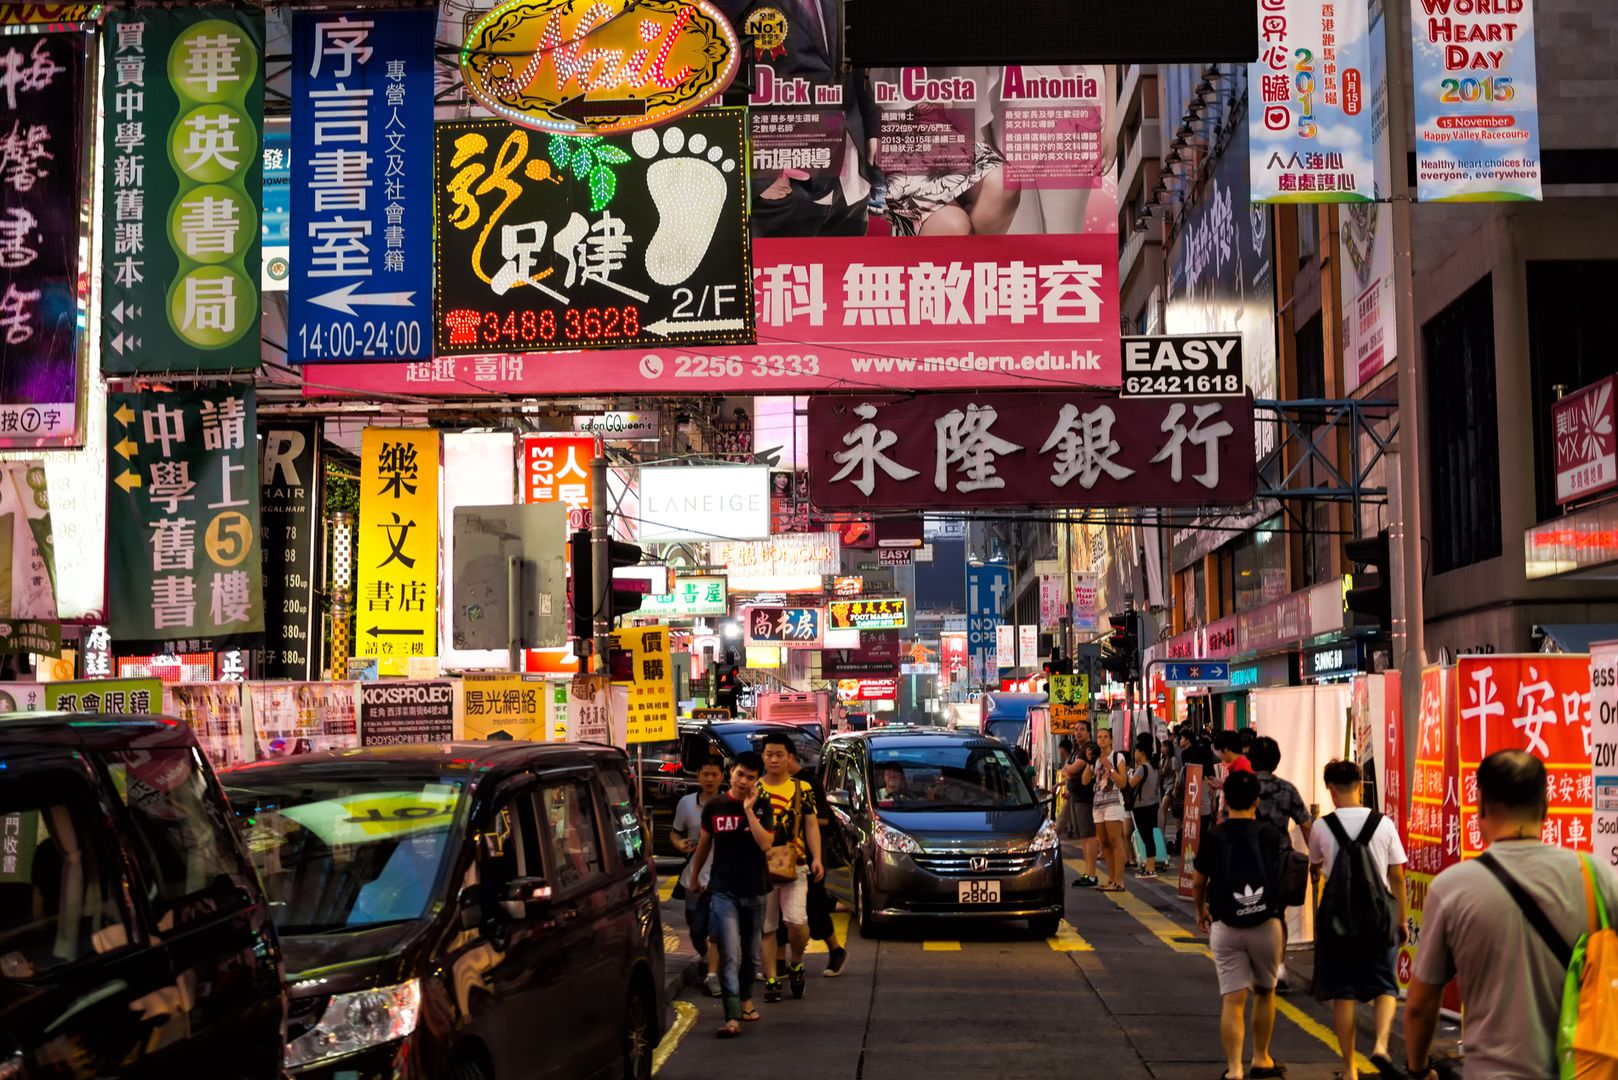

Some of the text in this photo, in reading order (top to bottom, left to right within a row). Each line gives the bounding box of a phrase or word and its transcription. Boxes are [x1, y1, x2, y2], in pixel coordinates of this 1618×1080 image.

[750, 22, 784, 34] No.1
[1428, 17, 1518, 42] HEART
[481, 0, 695, 96] Nail
[1445, 45, 1504, 70] DAY
[749, 65, 843, 105] Dick Hui
[876, 67, 976, 102] Dr. Costa
[1001, 65, 1099, 99] Antonia
[1295, 48, 1317, 139] 2015
[1440, 76, 1515, 102] 2015
[1442, 116, 1509, 128] 15 November
[308, 17, 375, 278] 序言書室
[1424, 129, 1529, 143] Happy Valley Racecourse
[113, 22, 146, 288] 買賣中學新舊課本
[263, 148, 291, 170] 發
[384, 60, 406, 272] 專營人文及社會書籍
[753, 148, 831, 170] 市場領導
[1267, 152, 1344, 170] 人人強心
[1421, 158, 1536, 171] Healthy heart choices for
[180, 34, 241, 334] 華英書局
[1279, 173, 1356, 191] 處處護心
[1420, 170, 1537, 182] everyone, everywhere
[671, 285, 737, 318] 2/F
[754, 260, 1104, 327] 科 無敵陣容
[483, 306, 639, 341] 3488 3628
[299, 321, 421, 357] 14:00-24:00
[674, 354, 820, 379] 2256 3333
[851, 350, 1101, 373] www.modern.edu.hk
[1125, 340, 1237, 371] EASY
[1127, 375, 1238, 393] 62421618
[1556, 407, 1578, 436] 美心
[828, 402, 1234, 497] 永隆銀行
[1557, 432, 1579, 466] MX
[532, 447, 553, 504] MONE
[648, 494, 760, 513] LANEIGE
[142, 403, 197, 630] 中學舊書
[286, 526, 297, 540] 78
[285, 549, 296, 562] 98
[880, 550, 909, 560] EASY
[284, 574, 307, 588] 150up
[283, 600, 306, 613] 200up
[365, 580, 426, 612] 書店
[970, 574, 1006, 614] i.t
[282, 625, 306, 639] 380up
[971, 618, 1005, 630] NOW
[970, 632, 997, 643] OPE
[86, 625, 111, 680] 府註
[282, 651, 305, 664] 380up
[57, 690, 151, 715] 都會眼鏡
[362, 686, 453, 704] KICKSPROJECT
[466, 690, 536, 715] 陽光網絡
[1541, 817, 1594, 850] 剷車
[962, 891, 998, 902] 2800
[1236, 903, 1267, 916] adidas
